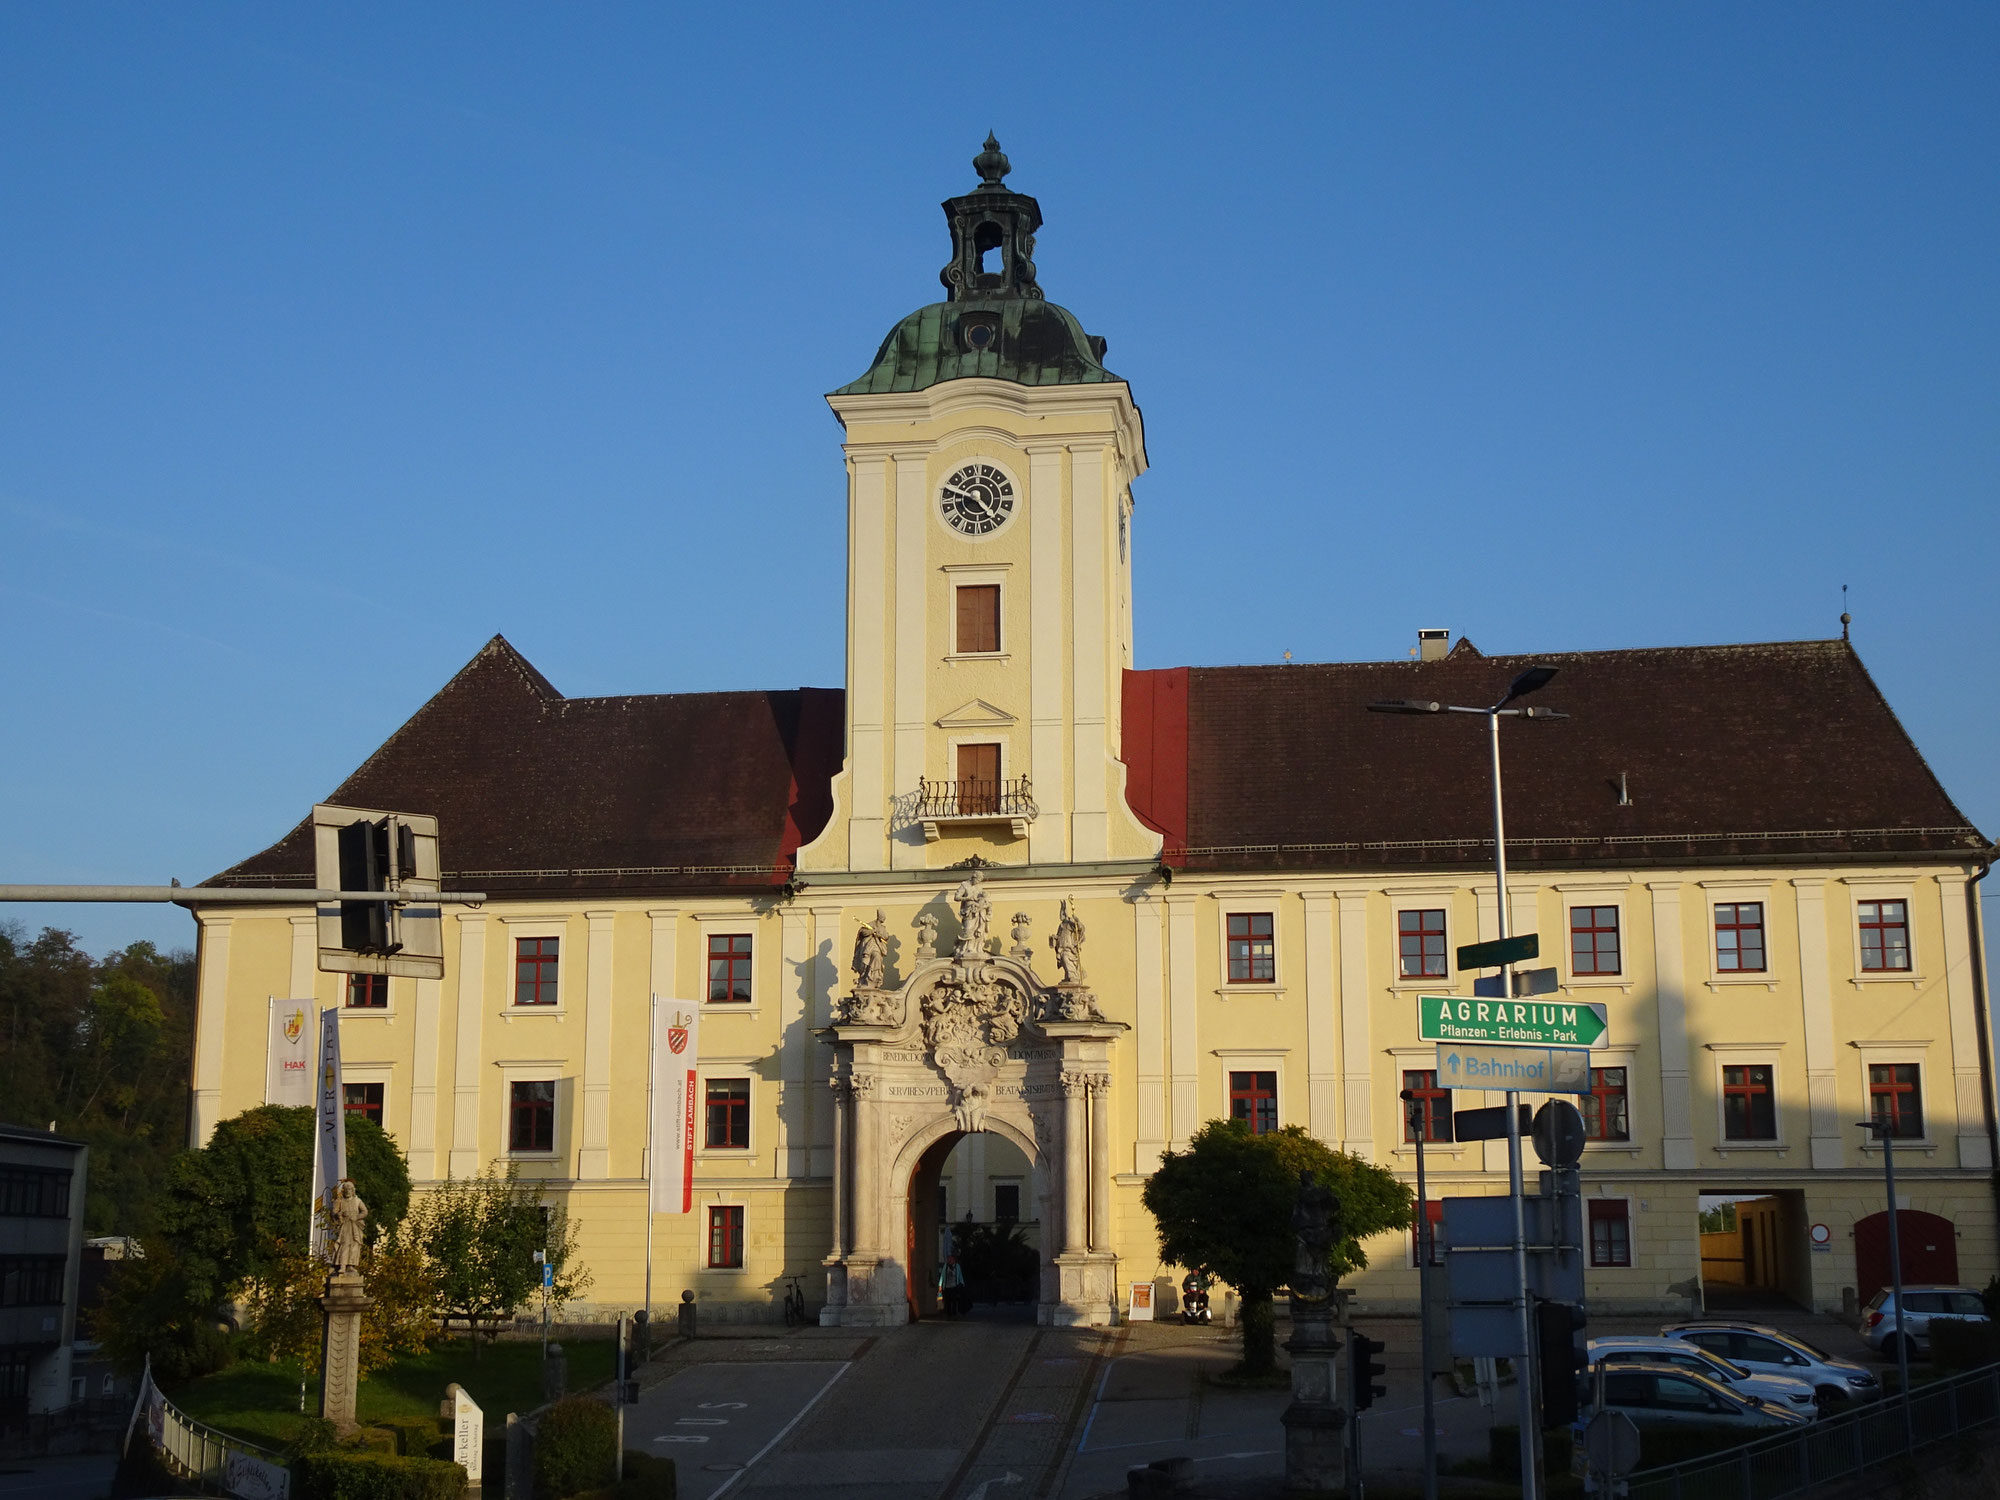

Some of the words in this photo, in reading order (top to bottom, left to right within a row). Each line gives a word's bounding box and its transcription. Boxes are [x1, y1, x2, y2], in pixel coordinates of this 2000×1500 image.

[1440, 1001, 1577, 1026] AGRARIUM
[1440, 1024, 1487, 1038] Pflanzen
[1499, 1027, 1542, 1040] Erlebnis
[1553, 1029, 1577, 1042] Park
[284, 1061, 306, 1069] HAK
[1466, 1057, 1544, 1078] Bahnhof
[545, 1267, 551, 1286] P
[653, 1402, 748, 1443] BUS
